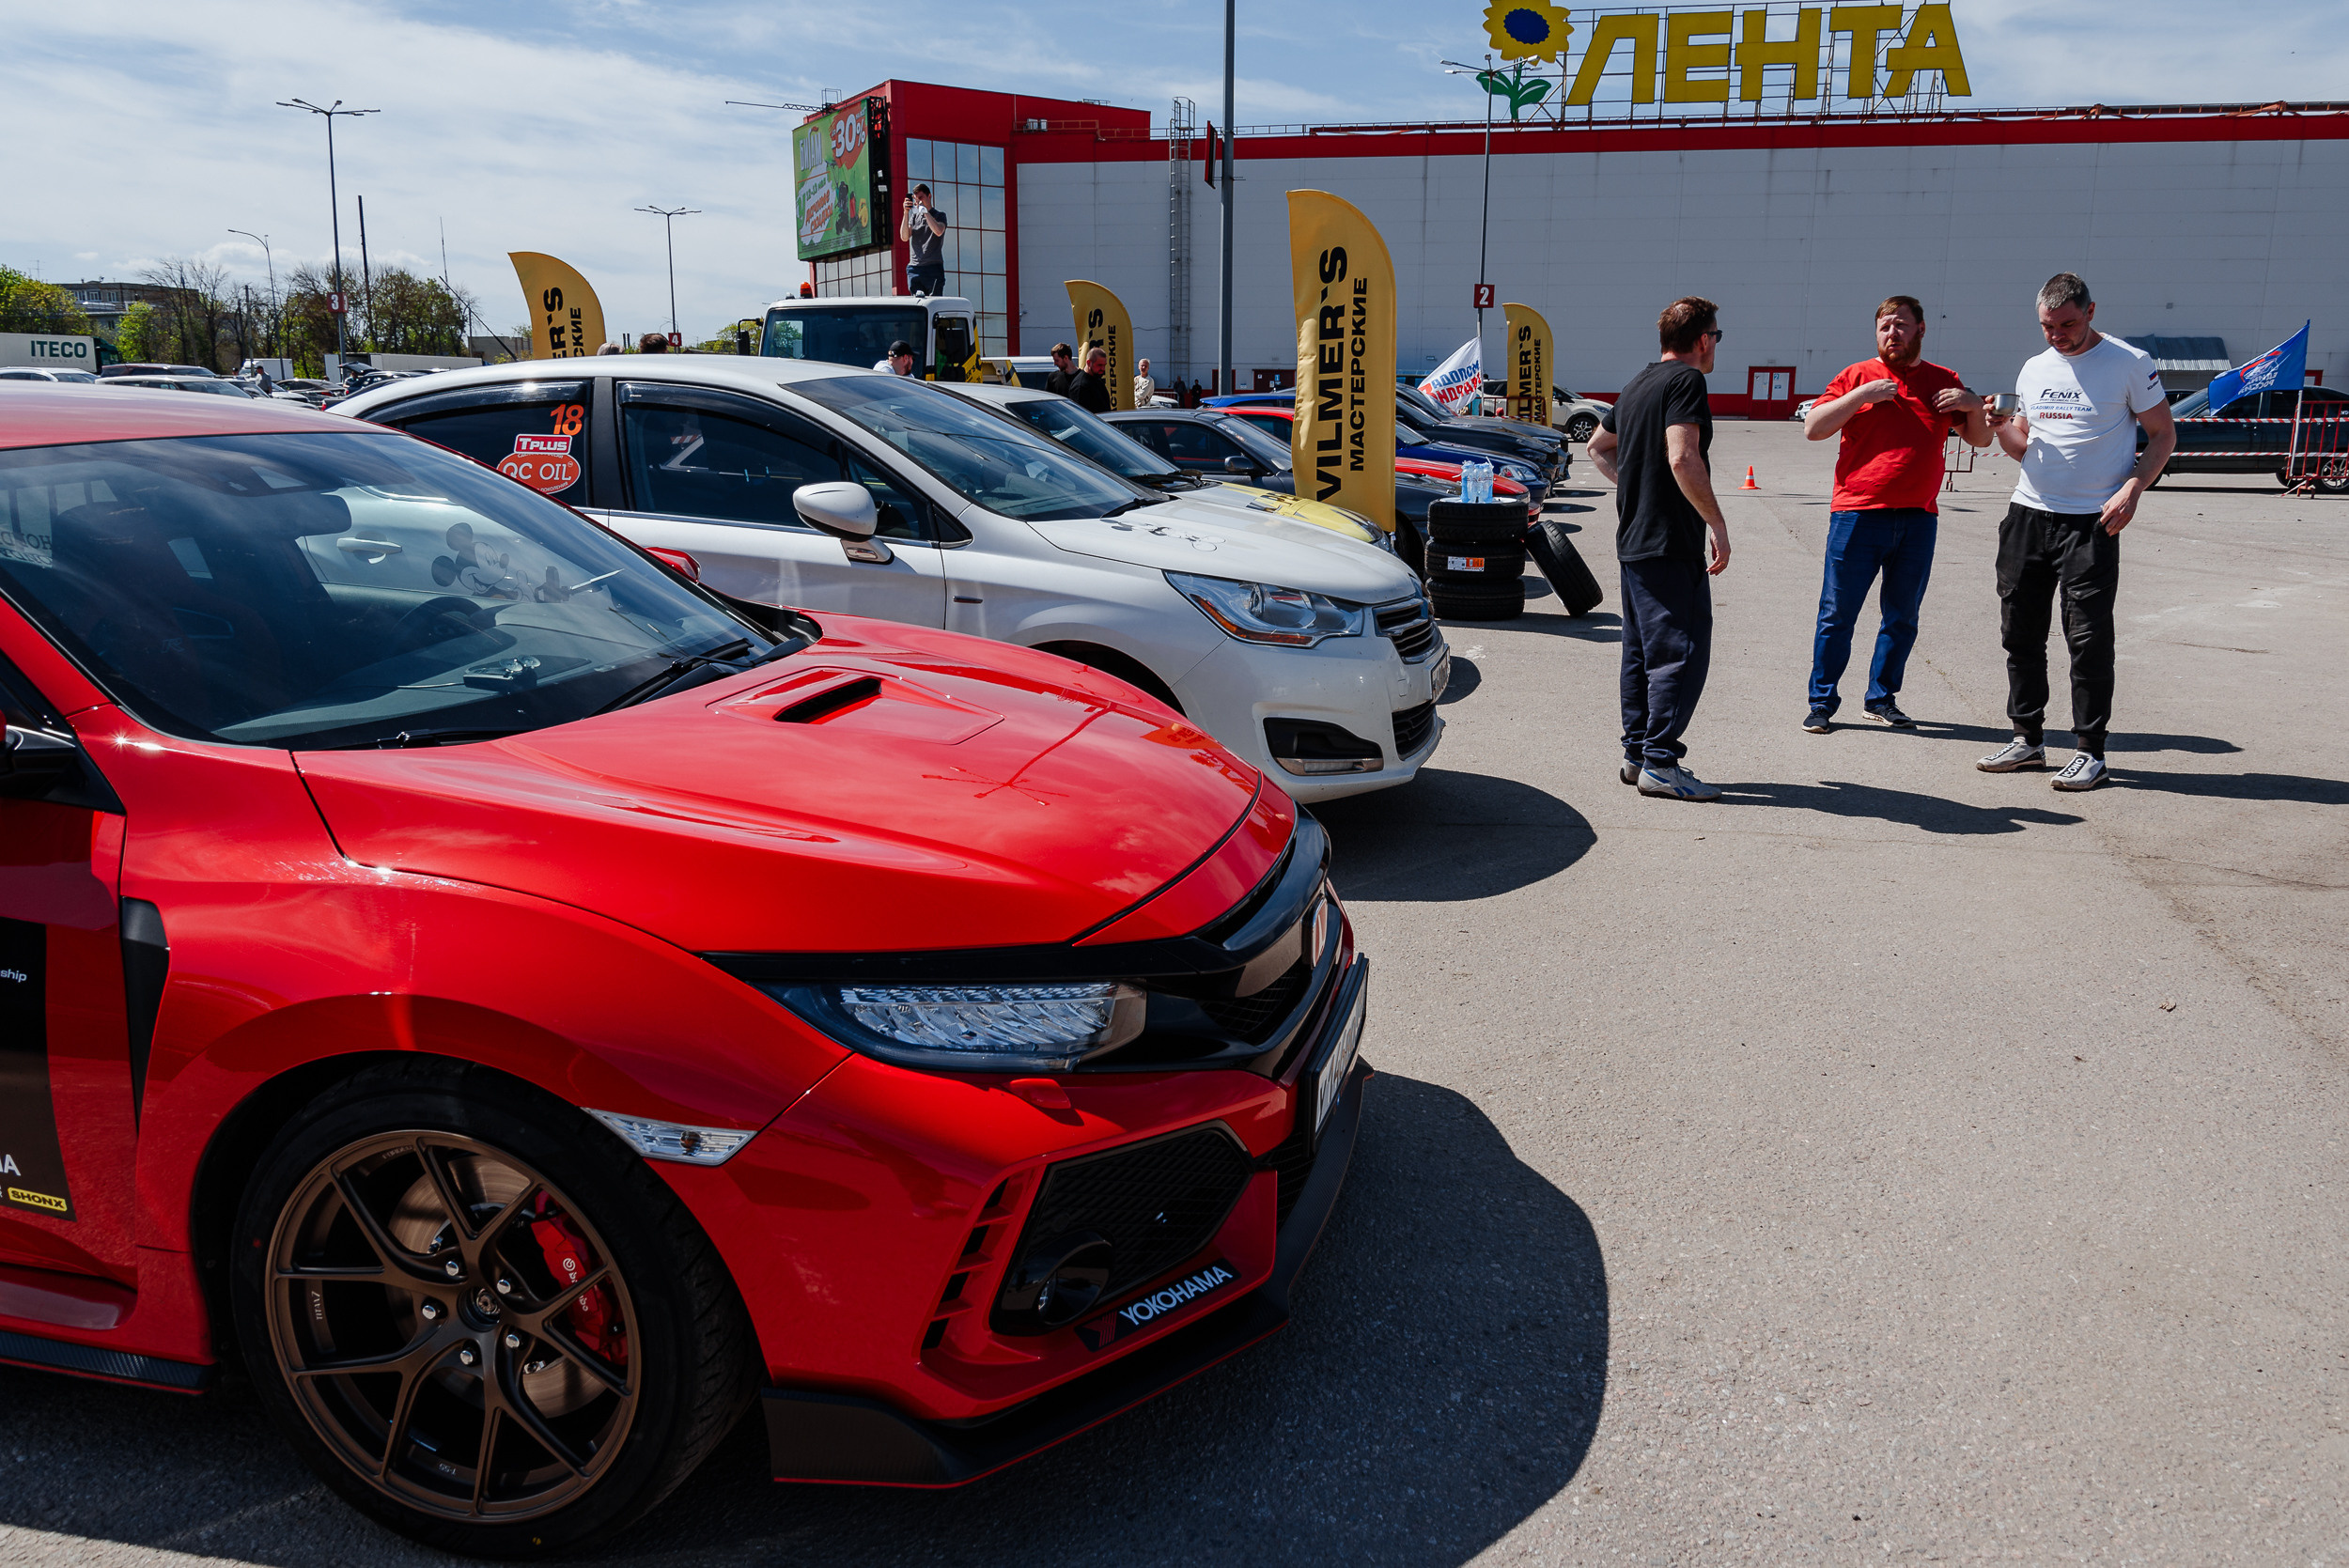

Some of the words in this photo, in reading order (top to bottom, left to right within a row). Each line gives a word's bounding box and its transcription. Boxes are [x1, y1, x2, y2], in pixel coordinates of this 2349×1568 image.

[1566, 4, 1971, 105] ЛЕНТА
[331, 294, 339, 310] 3
[1479, 287, 1489, 305] 2
[31, 340, 87, 358] ITECO
[1350, 277, 1367, 472] МАСТЕРСКИЕ
[550, 403, 584, 436] 18
[519, 438, 568, 452] TPLUS
[503, 462, 533, 480] QC
[539, 463, 571, 481] OIL
[0, 969, 27, 984] ship
[11, 1190, 64, 1209] SHONX
[568, 1271, 589, 1312] brbo
[1119, 1265, 1233, 1326] YOKOHAMA
